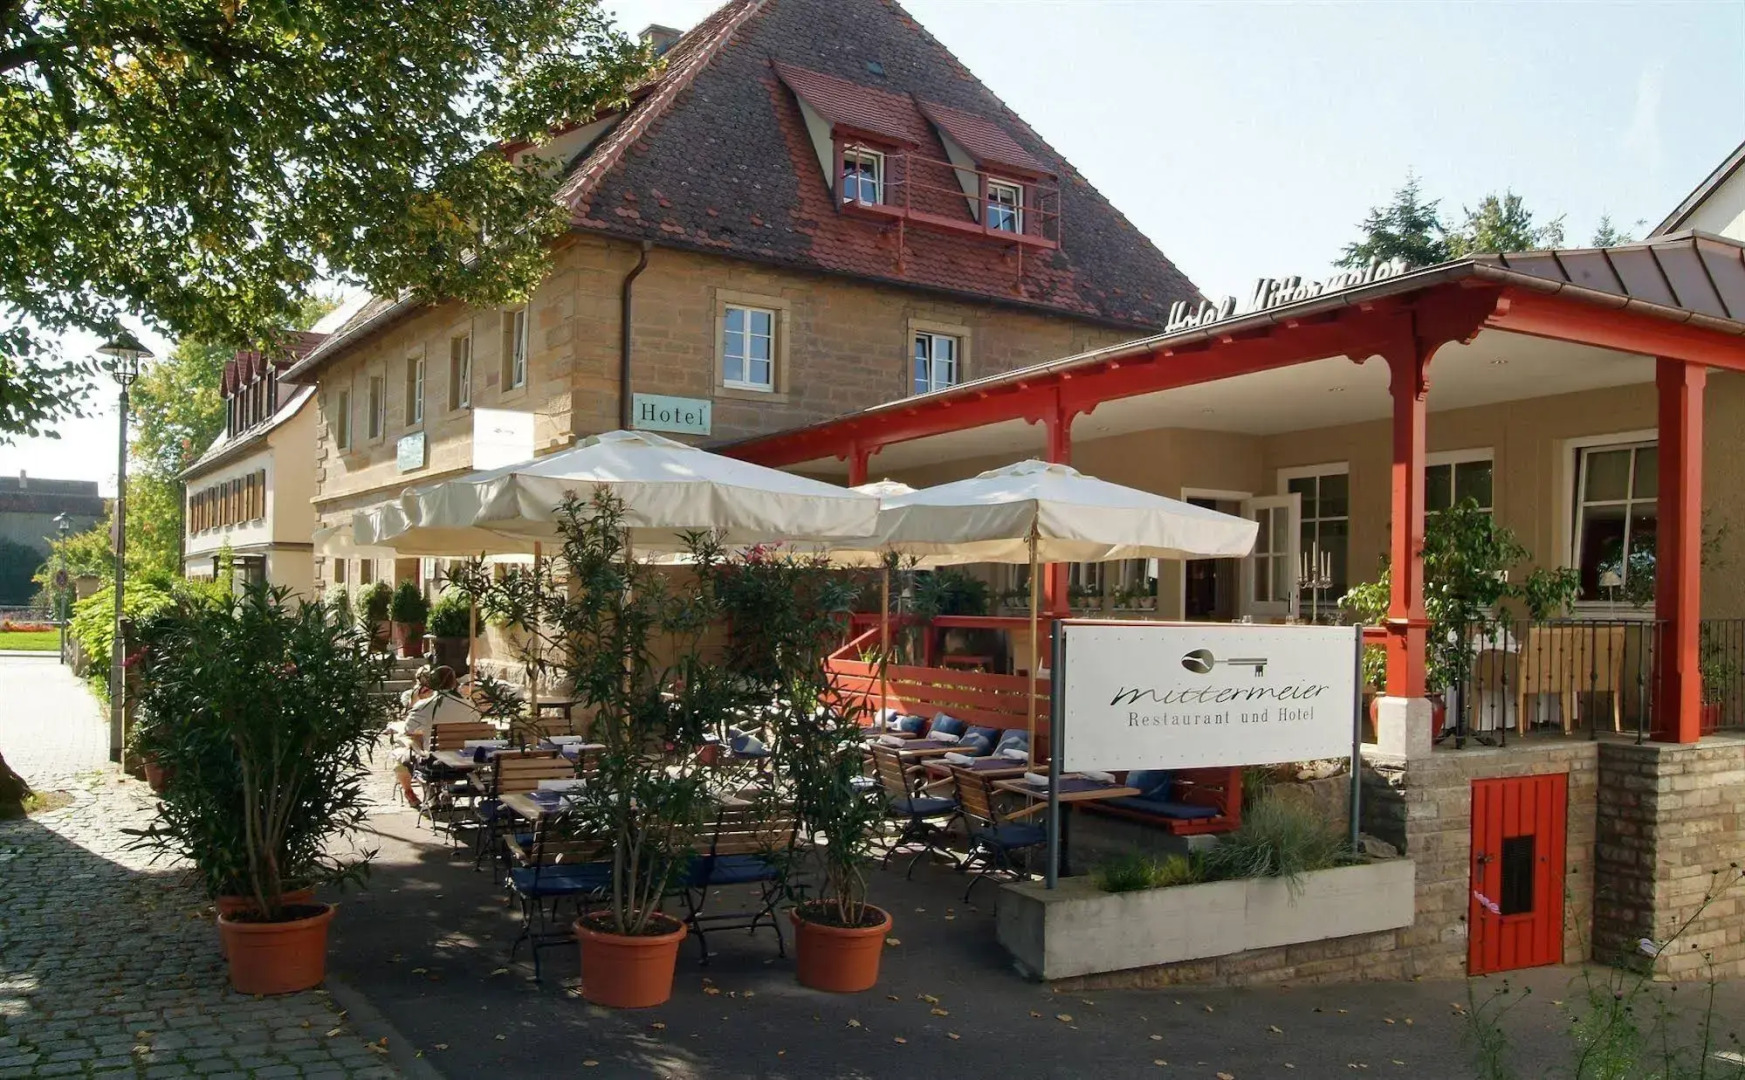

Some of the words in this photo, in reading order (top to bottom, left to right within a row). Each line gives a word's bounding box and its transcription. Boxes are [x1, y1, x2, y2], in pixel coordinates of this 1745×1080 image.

[1165, 296, 1236, 332] Hotel
[641, 403, 703, 426] Hotel
[1128, 710, 1230, 727] Restaurant
[1241, 708, 1268, 724] und
[1278, 706, 1315, 722] Hotel
